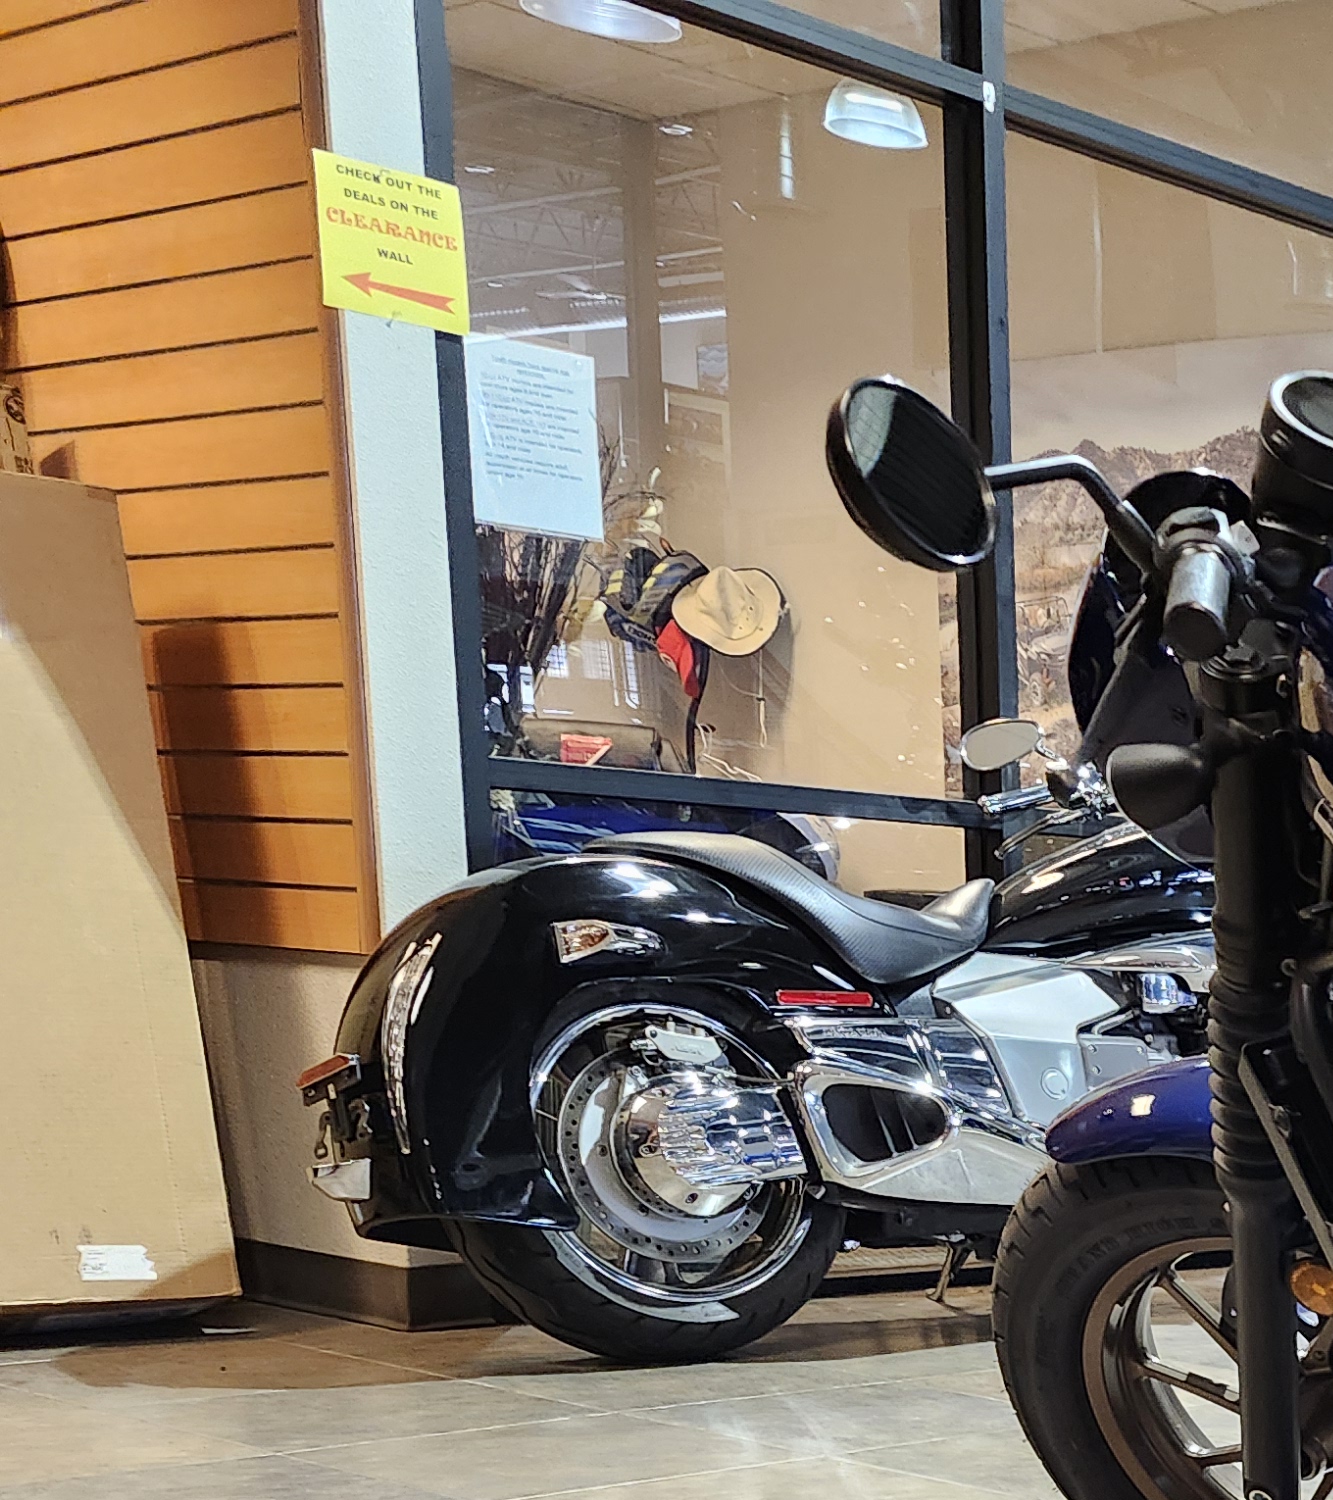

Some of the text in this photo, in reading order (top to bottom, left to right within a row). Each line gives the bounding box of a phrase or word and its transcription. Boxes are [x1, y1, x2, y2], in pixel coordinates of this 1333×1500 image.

[336, 164, 442, 200] CHECK OUT THE
[343, 187, 439, 220] DEALS ON THE
[326, 206, 458, 251] CLEARANCE
[376, 248, 414, 265] WALL
